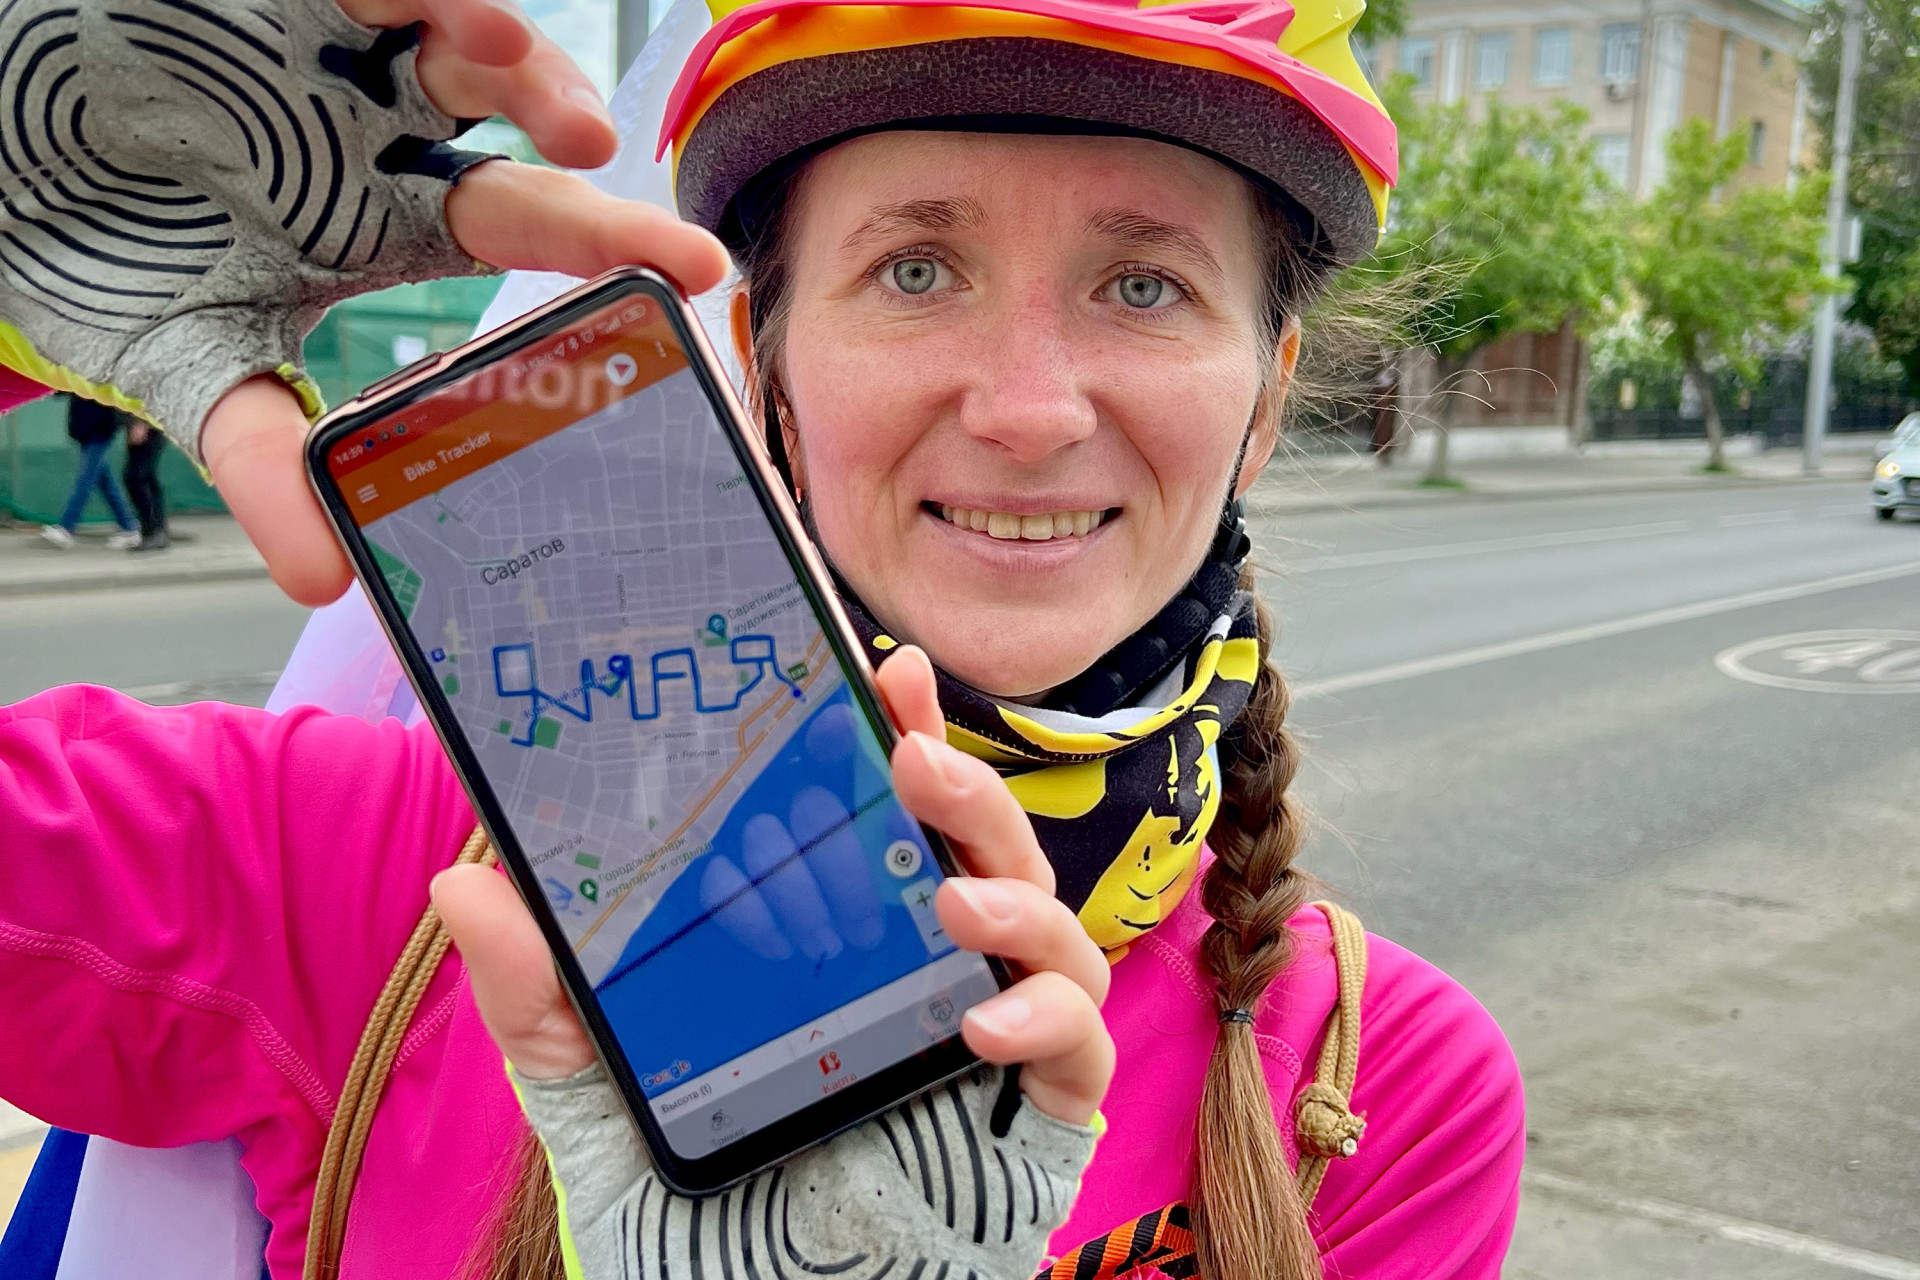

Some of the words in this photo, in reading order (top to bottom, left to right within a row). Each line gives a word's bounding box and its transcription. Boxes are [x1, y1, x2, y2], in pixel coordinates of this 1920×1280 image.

[403, 459, 437, 481] Bike
[437, 431, 491, 464] Tracker
[482, 537, 566, 586] Саратов
[598, 849, 659, 883] Городской
[606, 866, 658, 898] культуры
[641, 1059, 692, 1089] Google
[822, 1072, 858, 1096] Карта
[661, 1091, 701, 1115] Высота
